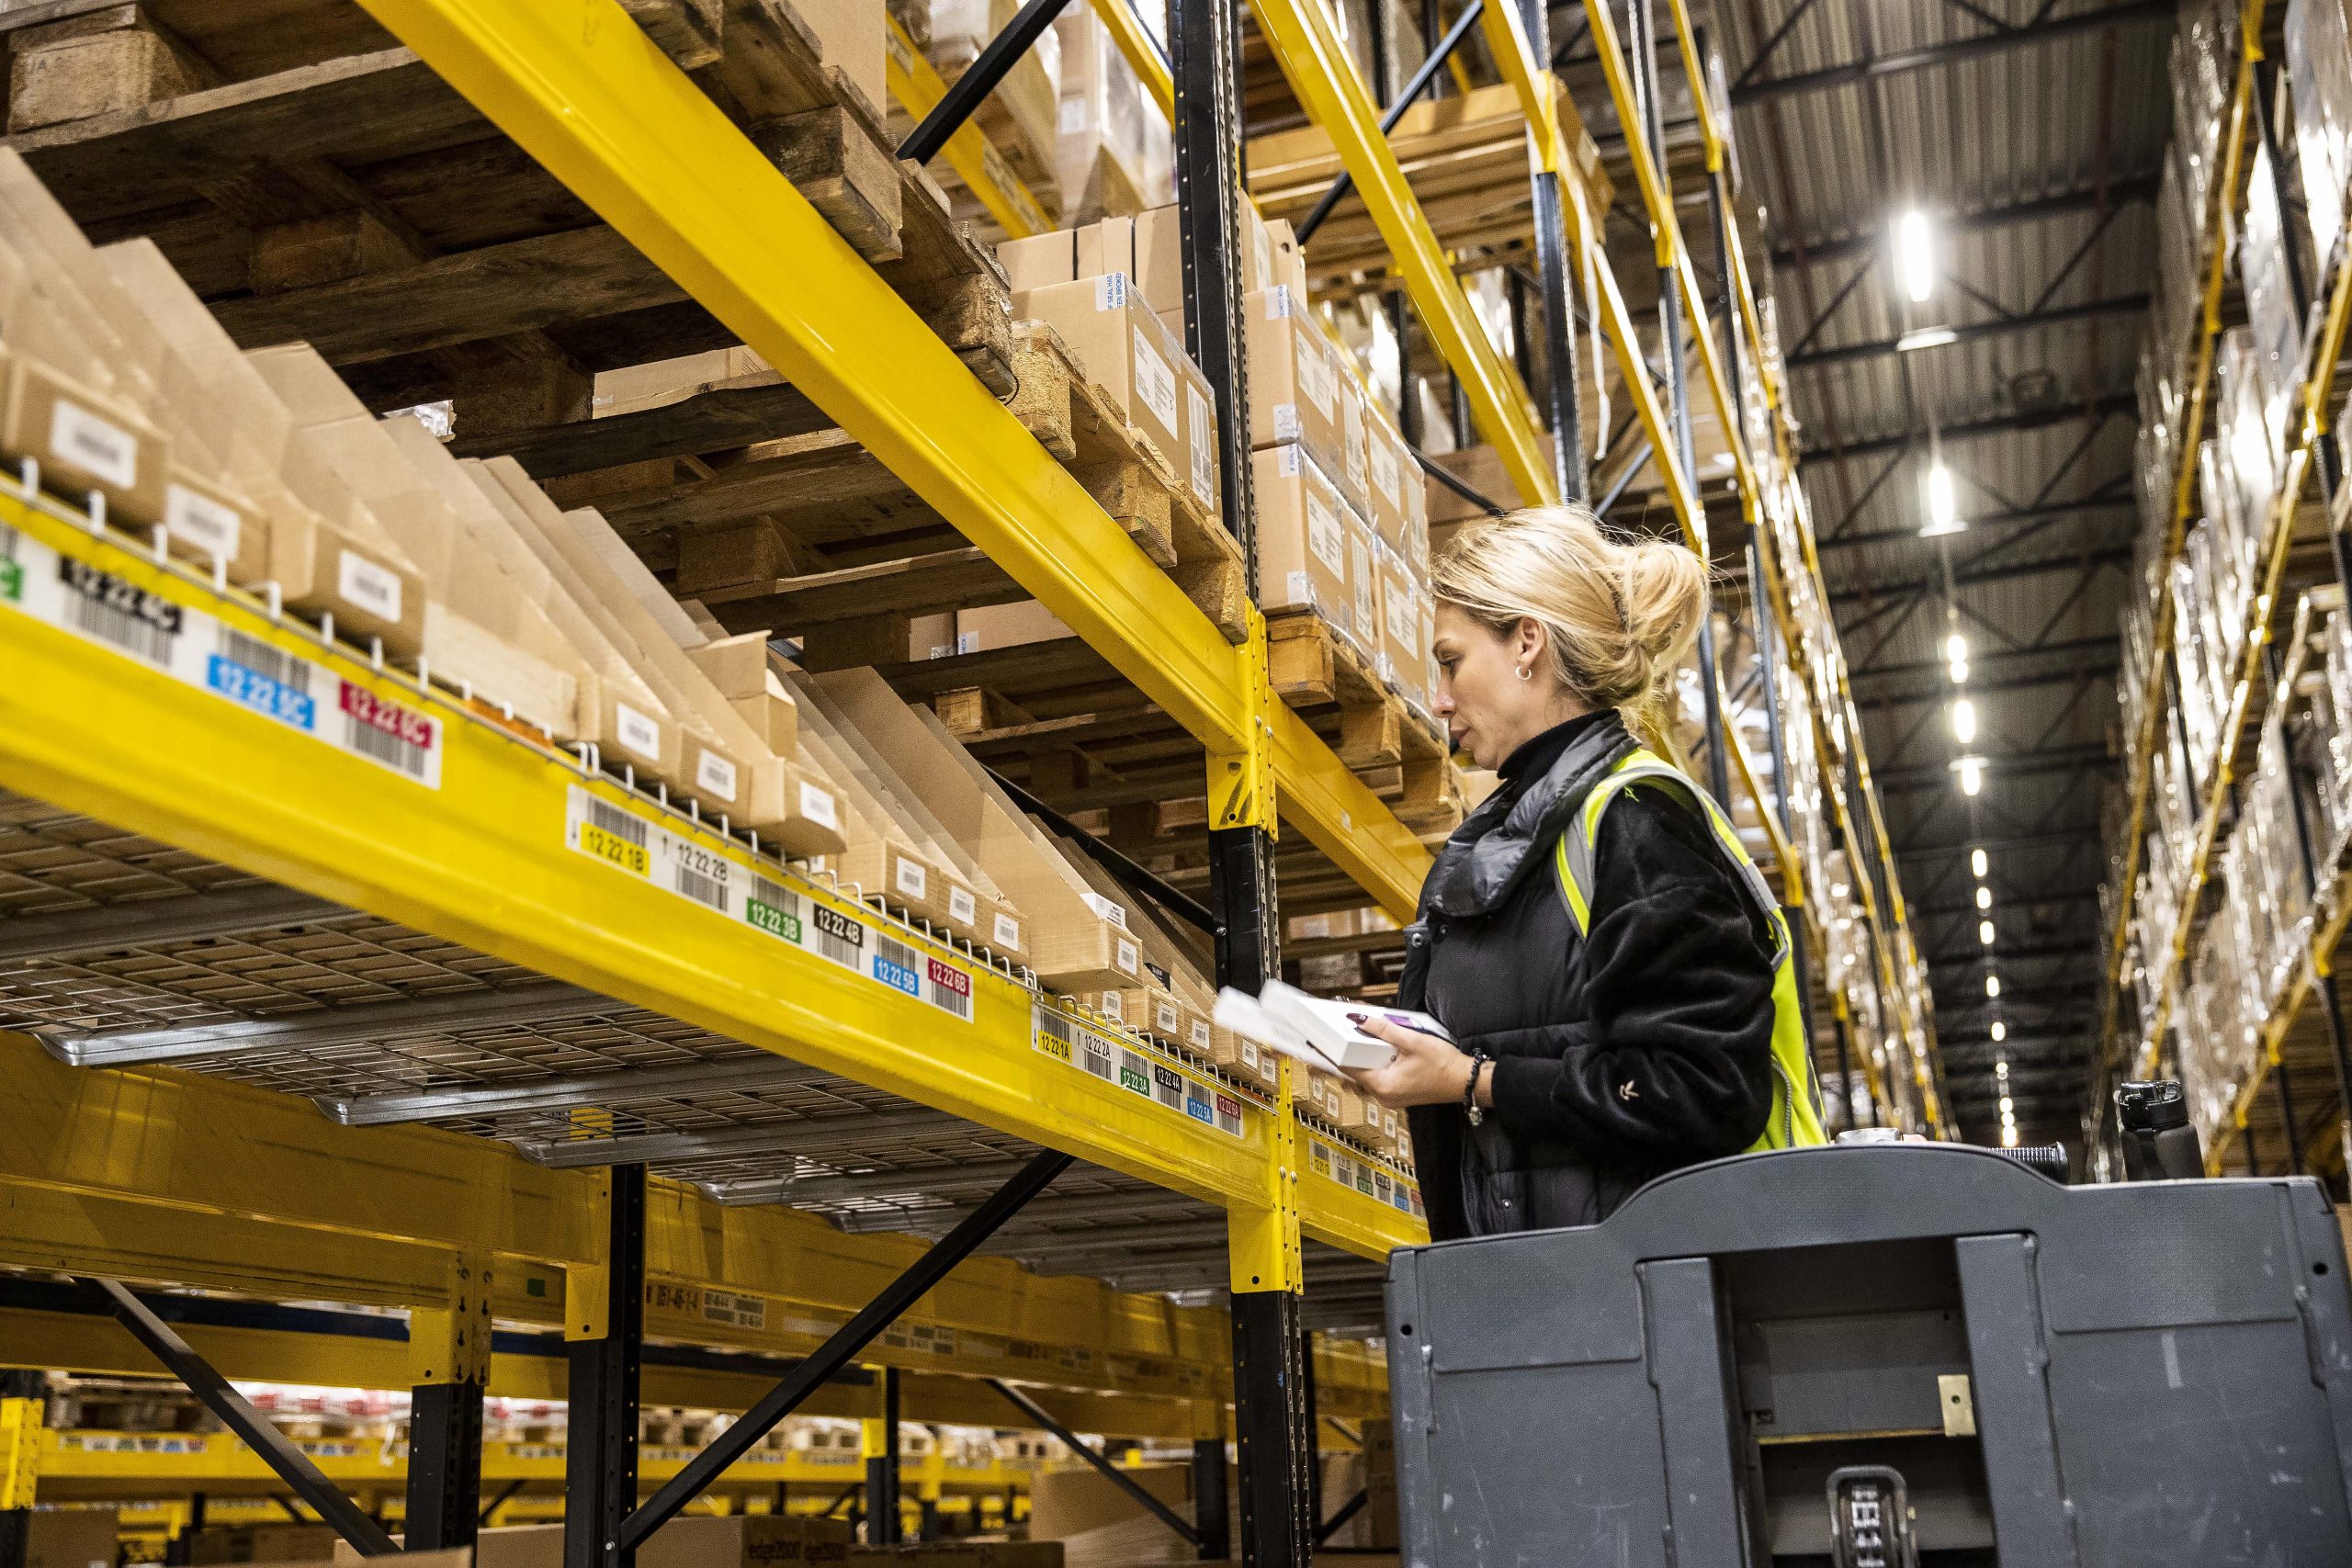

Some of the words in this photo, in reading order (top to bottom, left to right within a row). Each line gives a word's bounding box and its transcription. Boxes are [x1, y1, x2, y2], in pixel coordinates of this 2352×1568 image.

[589, 830, 604, 854] 12
[607, 838, 623, 863] 22
[628, 848, 644, 871] 1B
[678, 843, 692, 865] 12
[695, 850, 709, 874] 22
[712, 859, 728, 882] 2B
[752, 903, 765, 926] 12
[767, 909, 781, 932] 22
[783, 917, 797, 940] 3B
[818, 908, 831, 931] 12
[831, 915, 844, 937] 22
[846, 921, 860, 943] 4B
[877, 960, 889, 981] 12
[890, 965, 902, 987] 22
[903, 972, 915, 992] 5B
[932, 962, 943, 983] 12
[944, 967, 954, 987] 22
[955, 973, 967, 993] 6B
[1041, 1034, 1049, 1051] 12
[1051, 1038, 1059, 1055] 22
[1060, 1043, 1069, 1060] 1A
[1085, 1034, 1092, 1051] 12
[1093, 1038, 1102, 1055] 22
[1102, 1042, 1111, 1059] 2A
[1123, 1070, 1131, 1086] 12
[1131, 1074, 1139, 1089] 22
[1139, 1077, 1148, 1094] 3A
[1158, 1067, 1165, 1083] 12
[1165, 1071, 1172, 1087] 22
[1172, 1075, 1181, 1091] 4A
[1190, 1100, 1196, 1115] 12
[1196, 1103, 1204, 1118] 22
[1218, 1097, 1226, 1111] 12
[1226, 1100, 1232, 1114] 22
